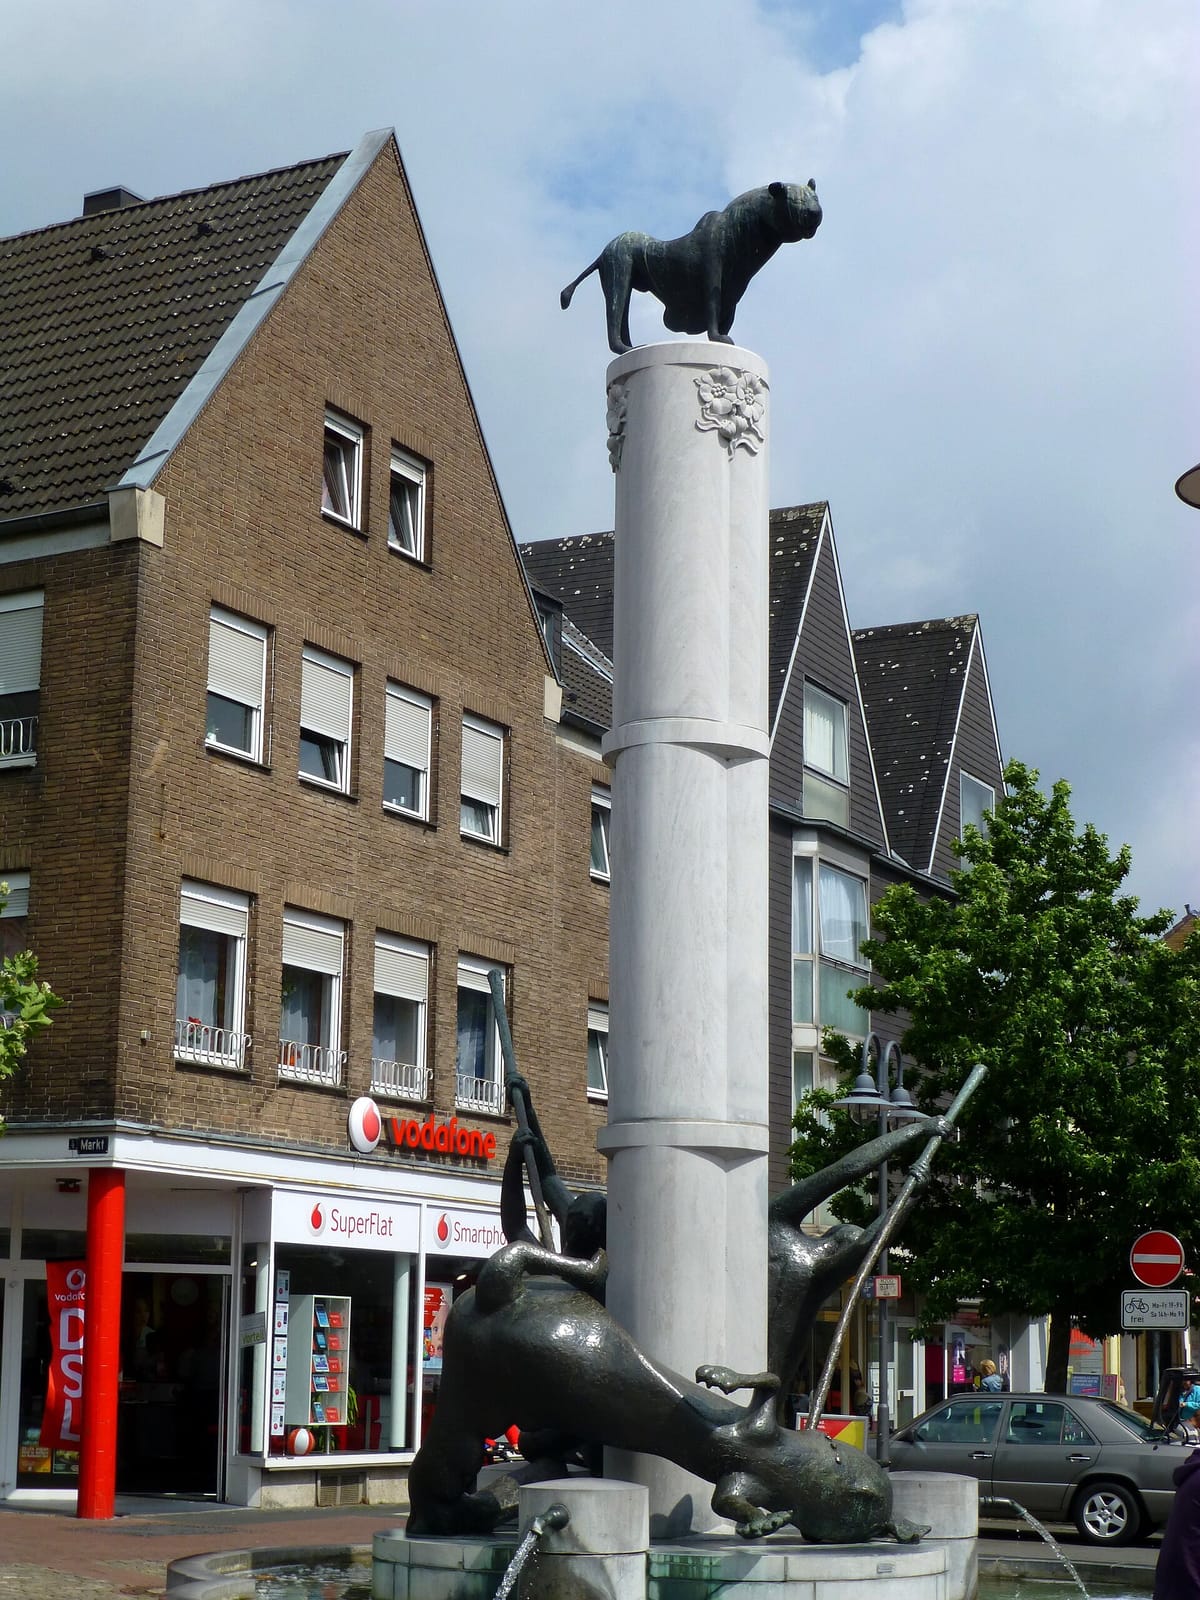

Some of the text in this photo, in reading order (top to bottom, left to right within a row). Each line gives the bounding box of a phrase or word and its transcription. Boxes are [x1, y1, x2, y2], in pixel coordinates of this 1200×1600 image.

[80, 1138, 105, 1151] Markt
[391, 1113, 496, 1159] vodafone
[330, 1209, 393, 1239] SuperFlat
[1130, 1315, 1144, 1323] frei
